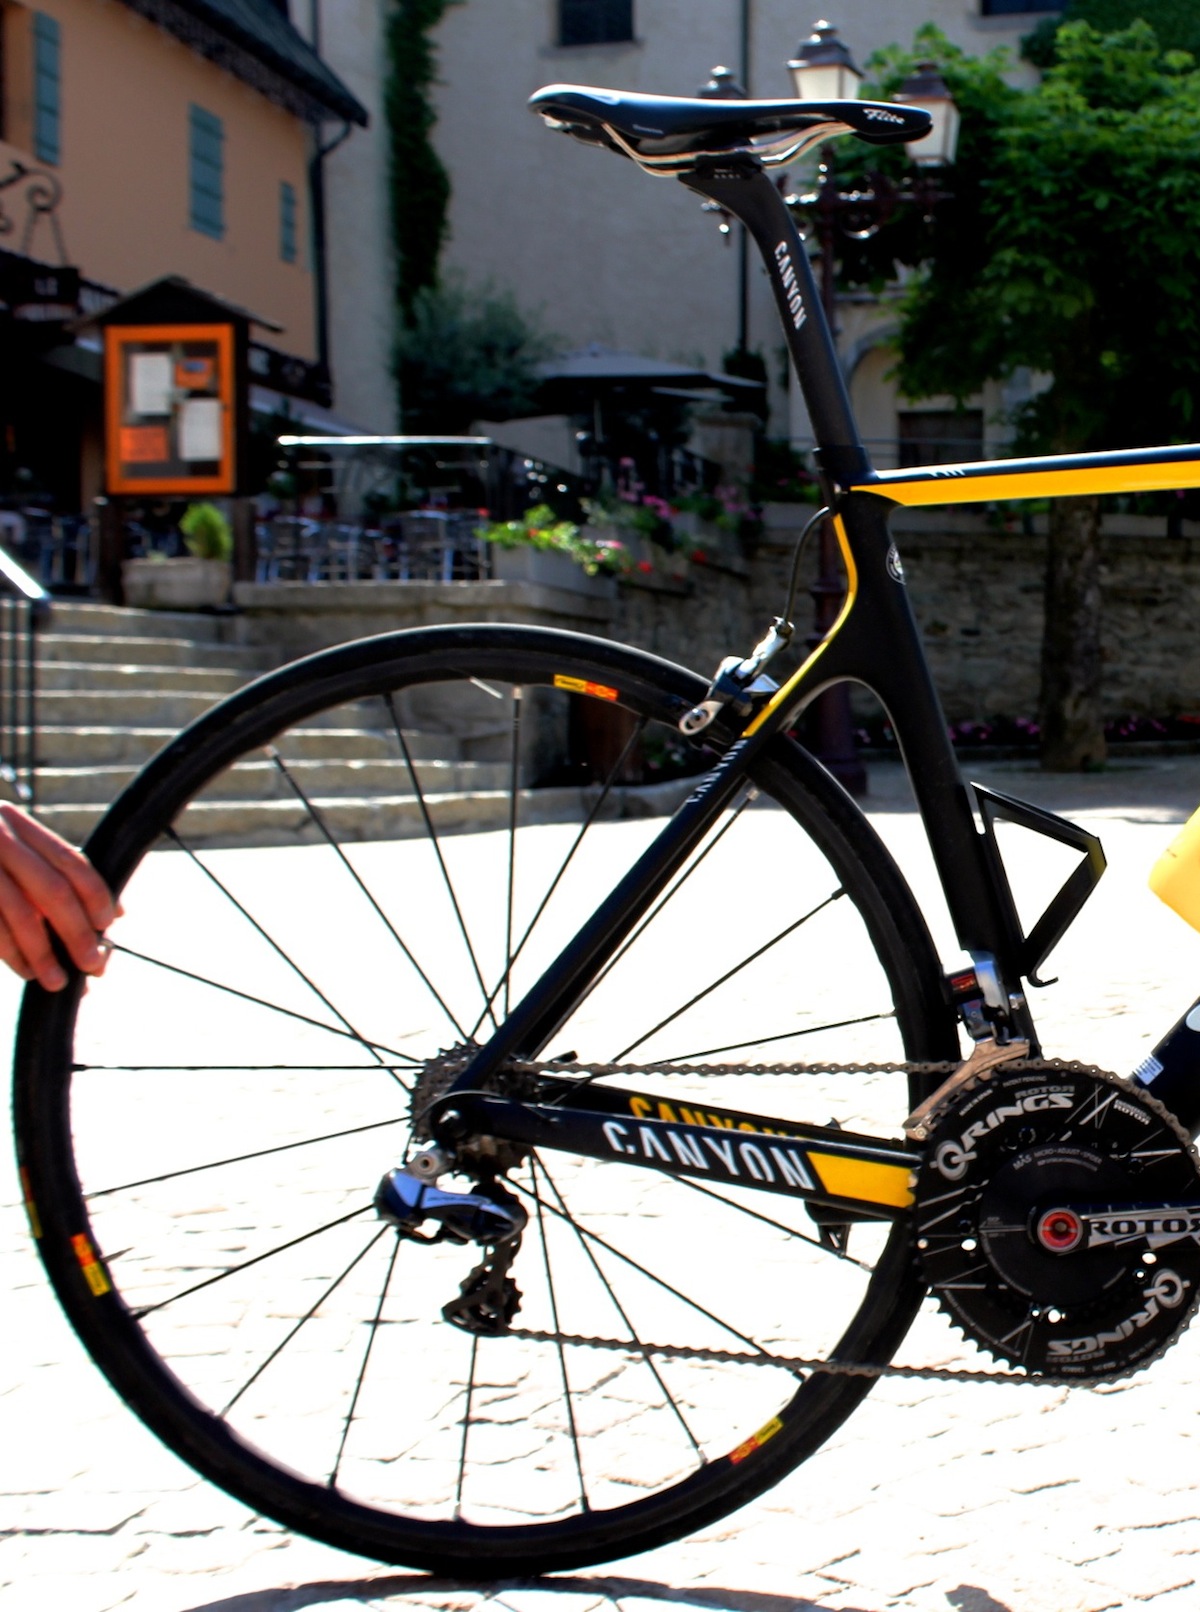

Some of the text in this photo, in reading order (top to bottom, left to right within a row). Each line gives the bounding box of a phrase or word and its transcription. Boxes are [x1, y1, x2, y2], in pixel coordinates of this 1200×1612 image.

[774, 241, 807, 330] CANYON
[1014, 1085, 1075, 1099] ROTOR
[602, 1121, 815, 1191] CANYON
